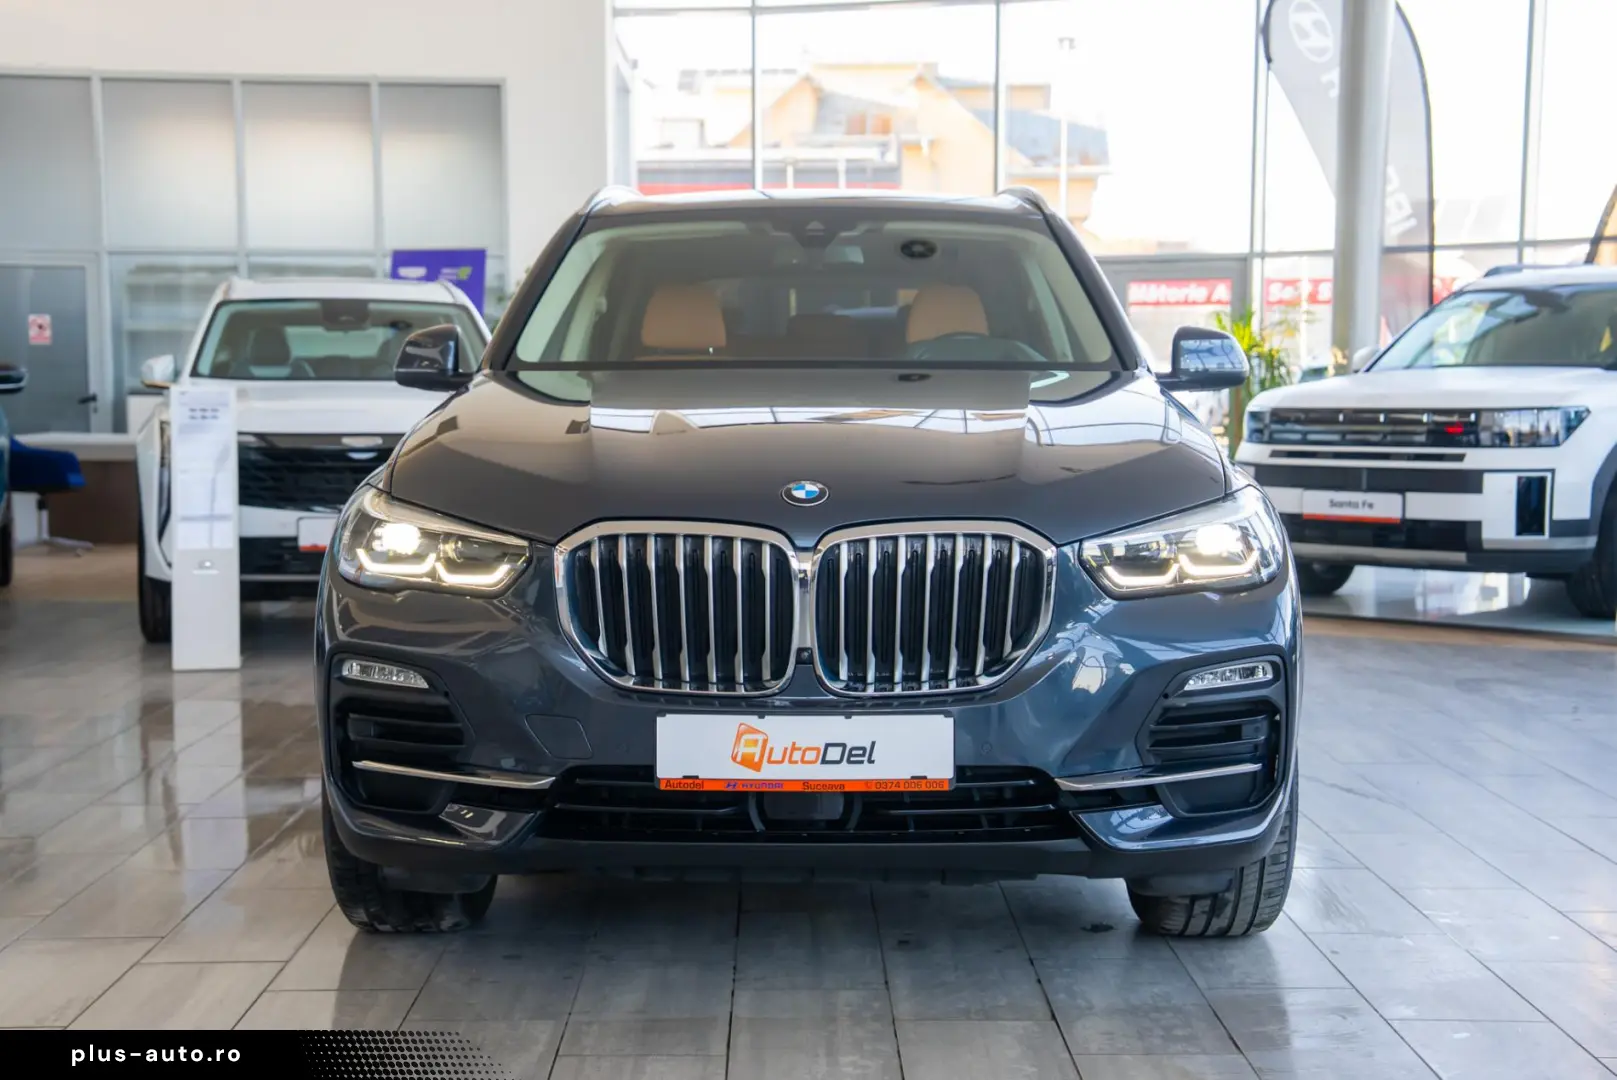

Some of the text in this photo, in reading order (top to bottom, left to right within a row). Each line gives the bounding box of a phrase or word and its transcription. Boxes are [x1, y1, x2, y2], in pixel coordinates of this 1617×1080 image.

[1329, 499, 1374, 510] Santa Fe
[732, 728, 876, 767] AutoDel
[664, 780, 705, 790] Autodel
[802, 781, 845, 791] Suceava
[875, 780, 900, 790] 0374
[903, 780, 923, 790] 006
[925, 780, 945, 789] 006
